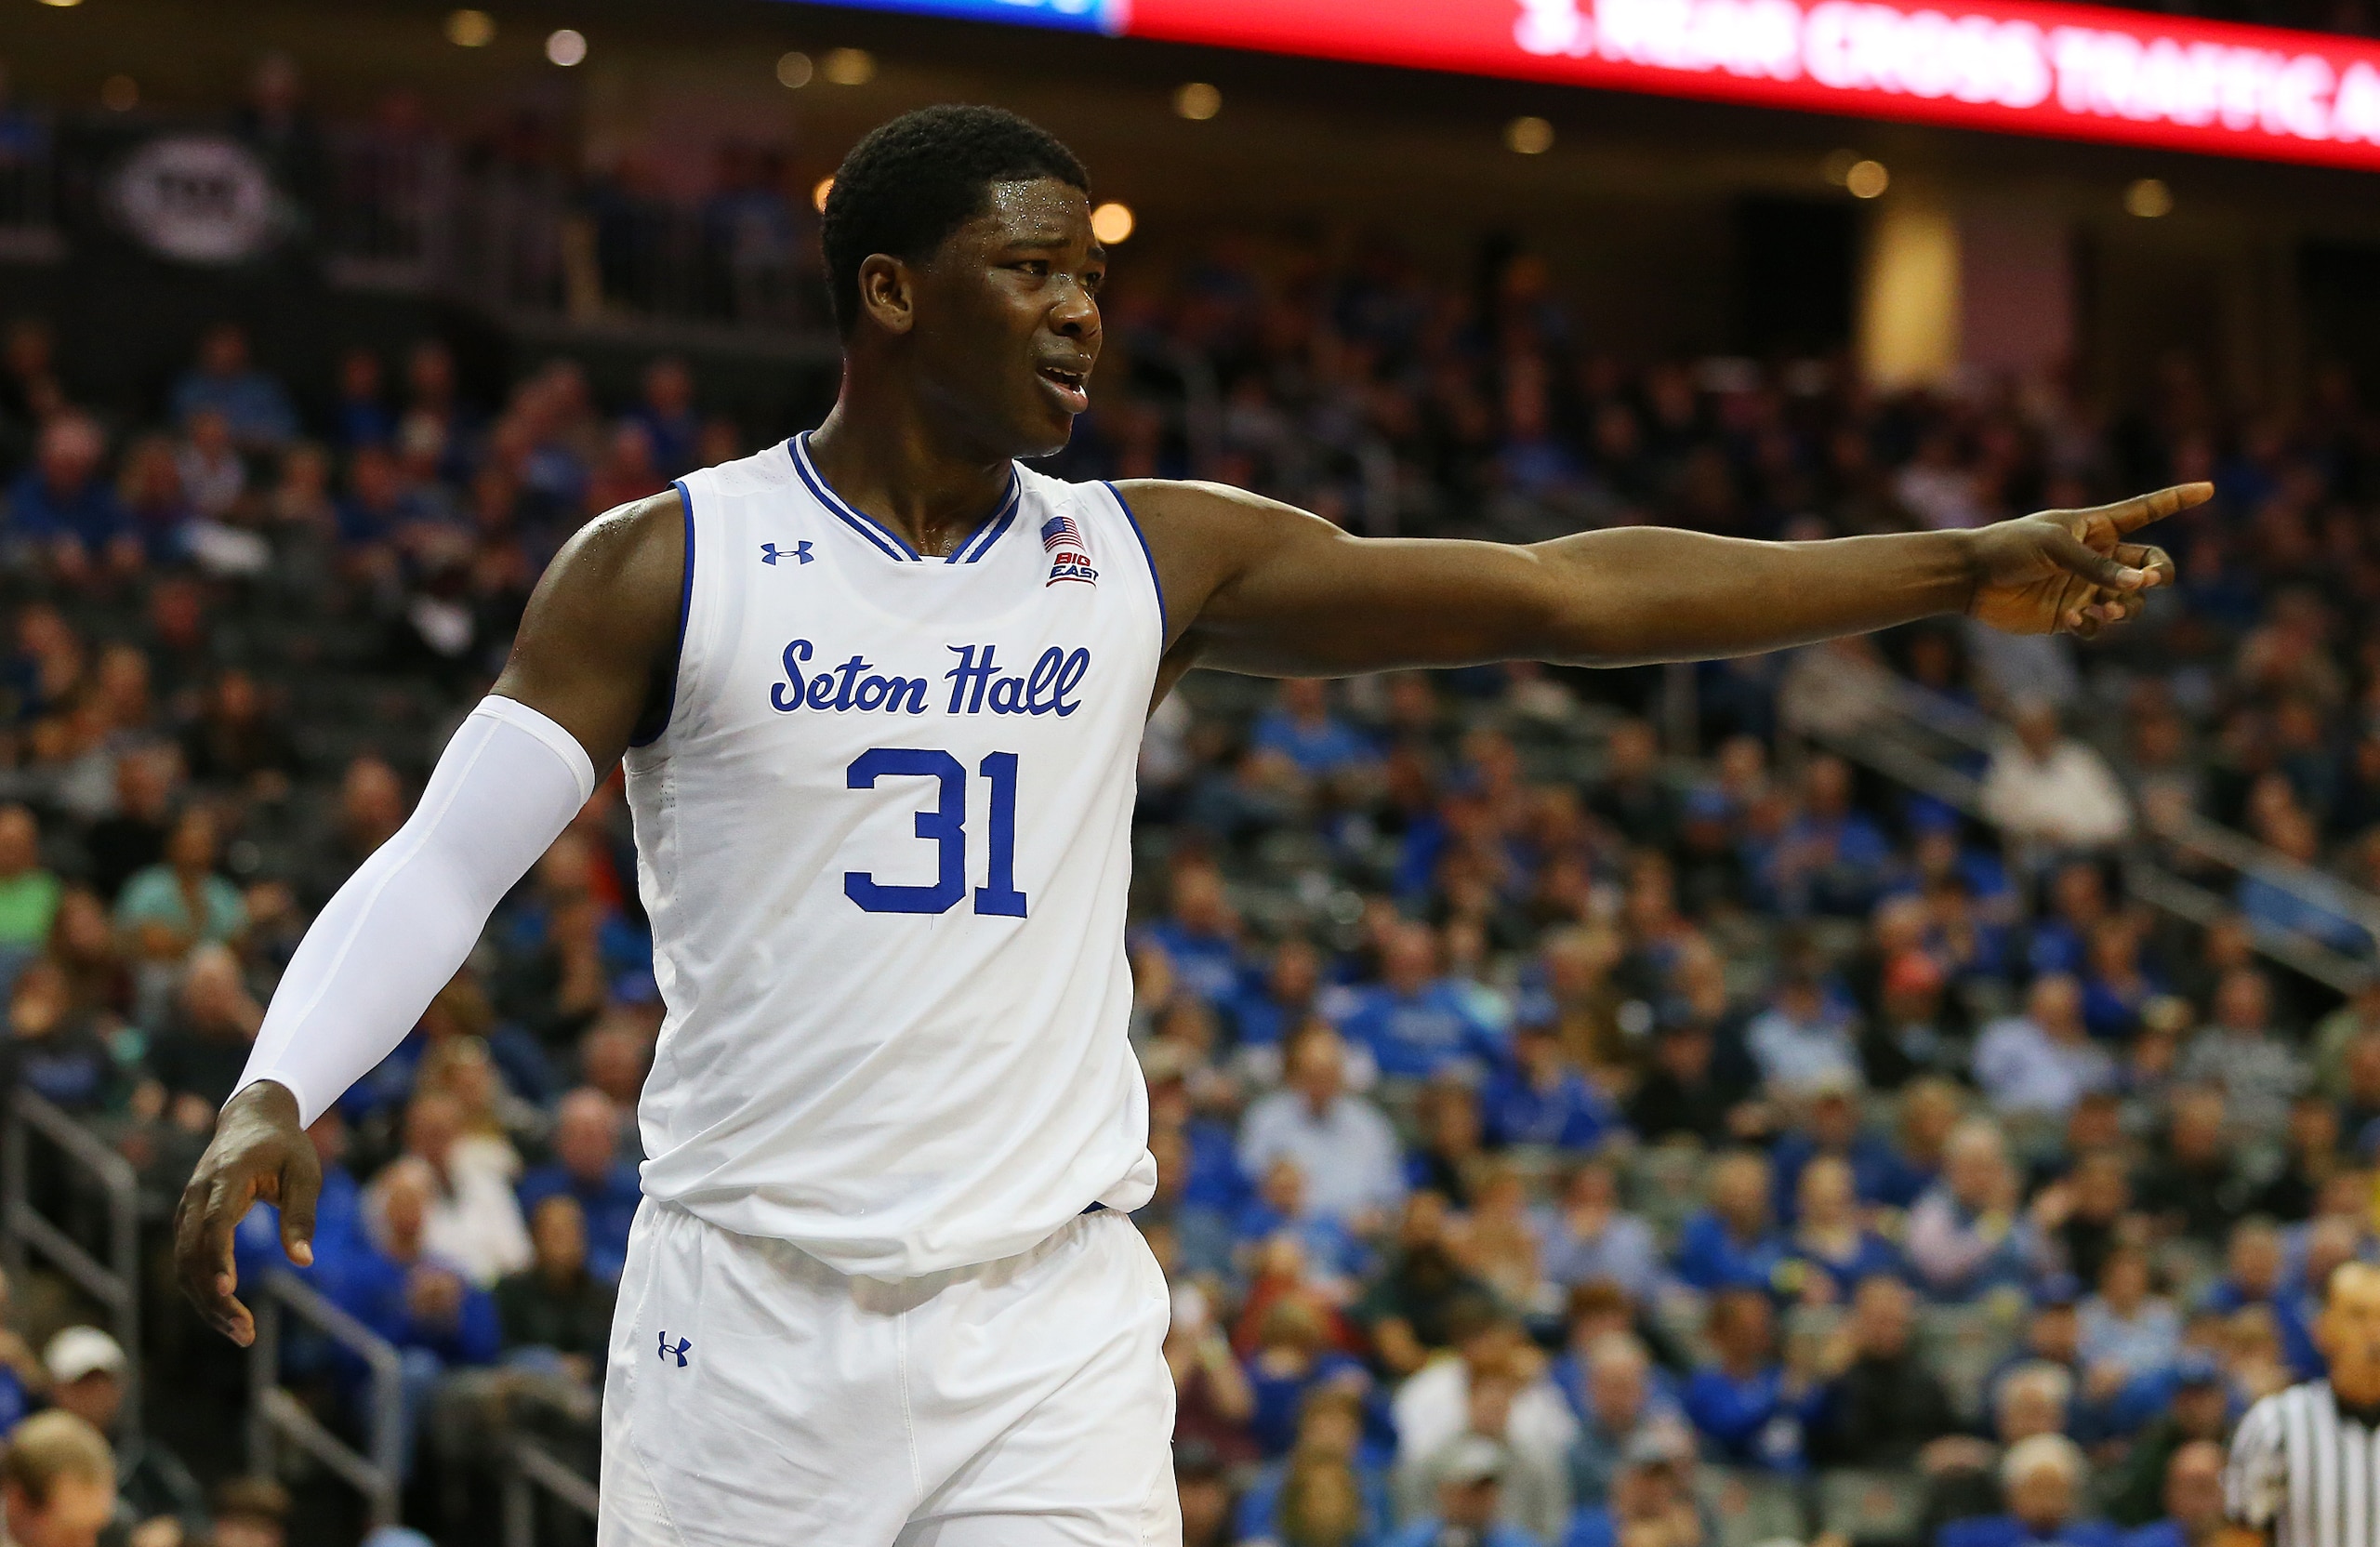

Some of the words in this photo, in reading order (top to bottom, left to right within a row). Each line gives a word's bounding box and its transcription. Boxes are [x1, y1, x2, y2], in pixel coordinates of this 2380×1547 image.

[1804, 3, 2049, 108] CROSS
[1049, 564, 1099, 582] EAST
[1053, 551, 1091, 567] BIG
[770, 639, 929, 714] Seton
[944, 643, 1091, 717] Hall
[843, 747, 1028, 919] 31
